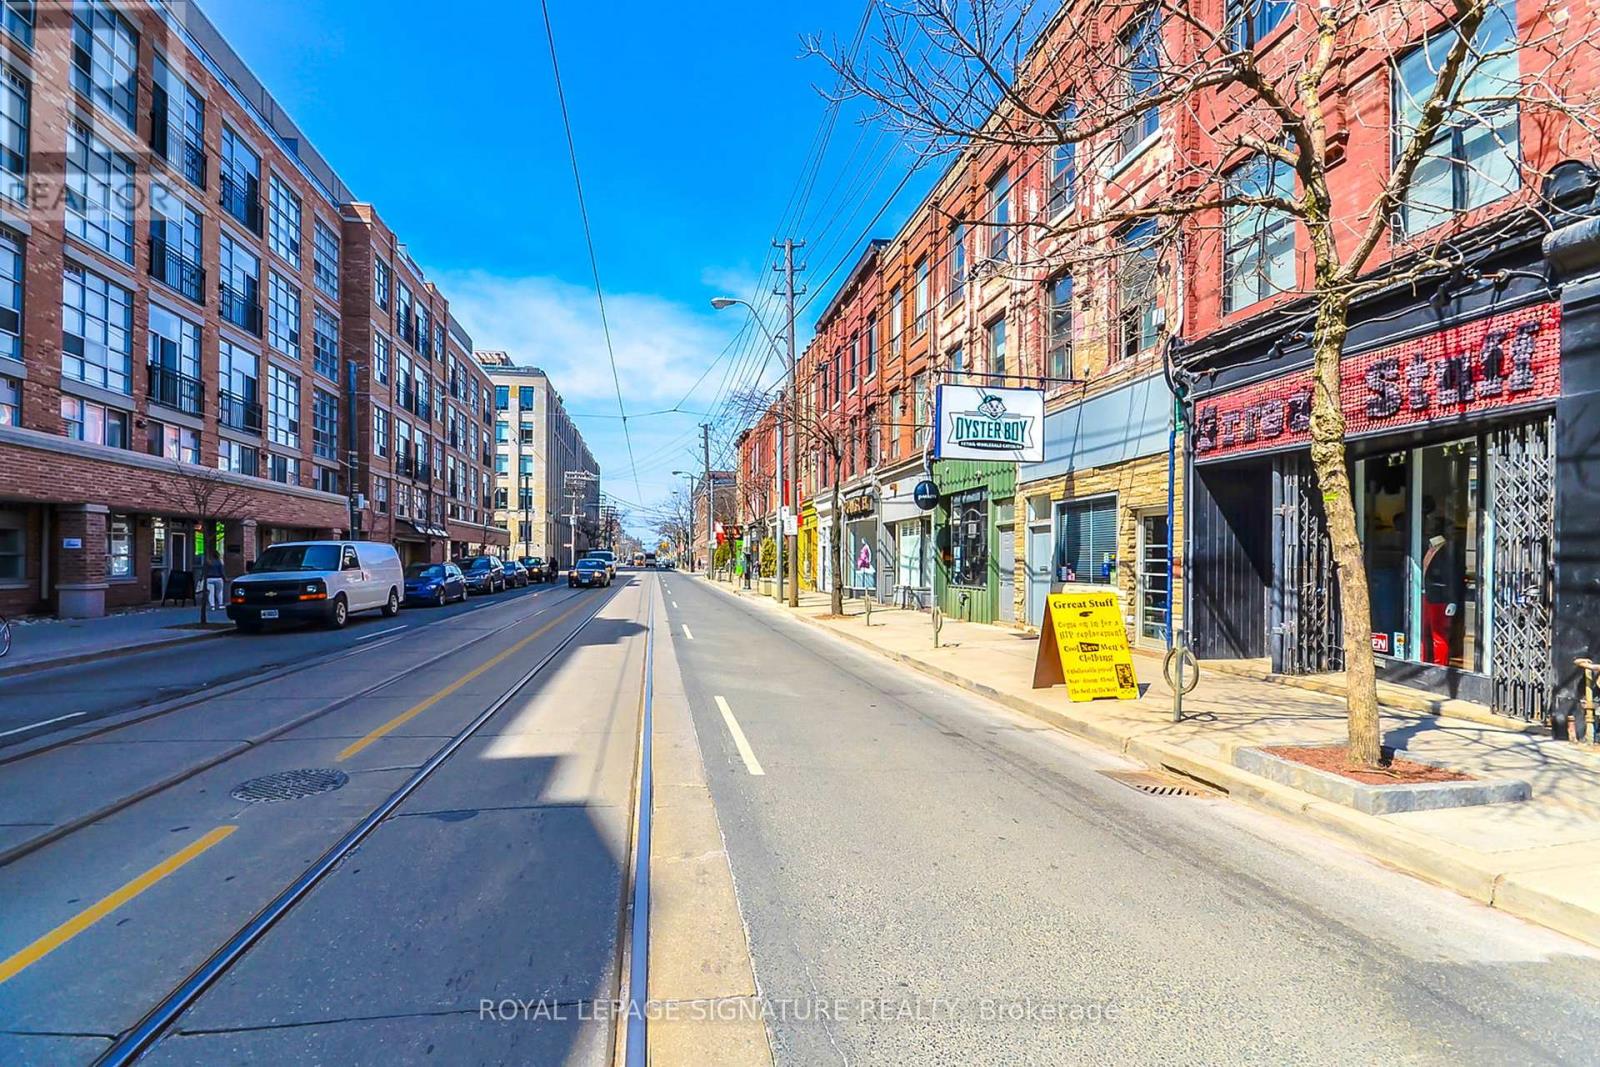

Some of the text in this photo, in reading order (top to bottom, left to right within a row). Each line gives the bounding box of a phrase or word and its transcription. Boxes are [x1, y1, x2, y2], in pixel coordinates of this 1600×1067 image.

[1195, 319, 1540, 453] Grrea Stuff
[956, 417, 1028, 443] OYSTER BOY
[1053, 598, 1114, 609] Grreat Stuff
[1081, 643, 1099, 652] New
[1079, 653, 1114, 663] Clothing
